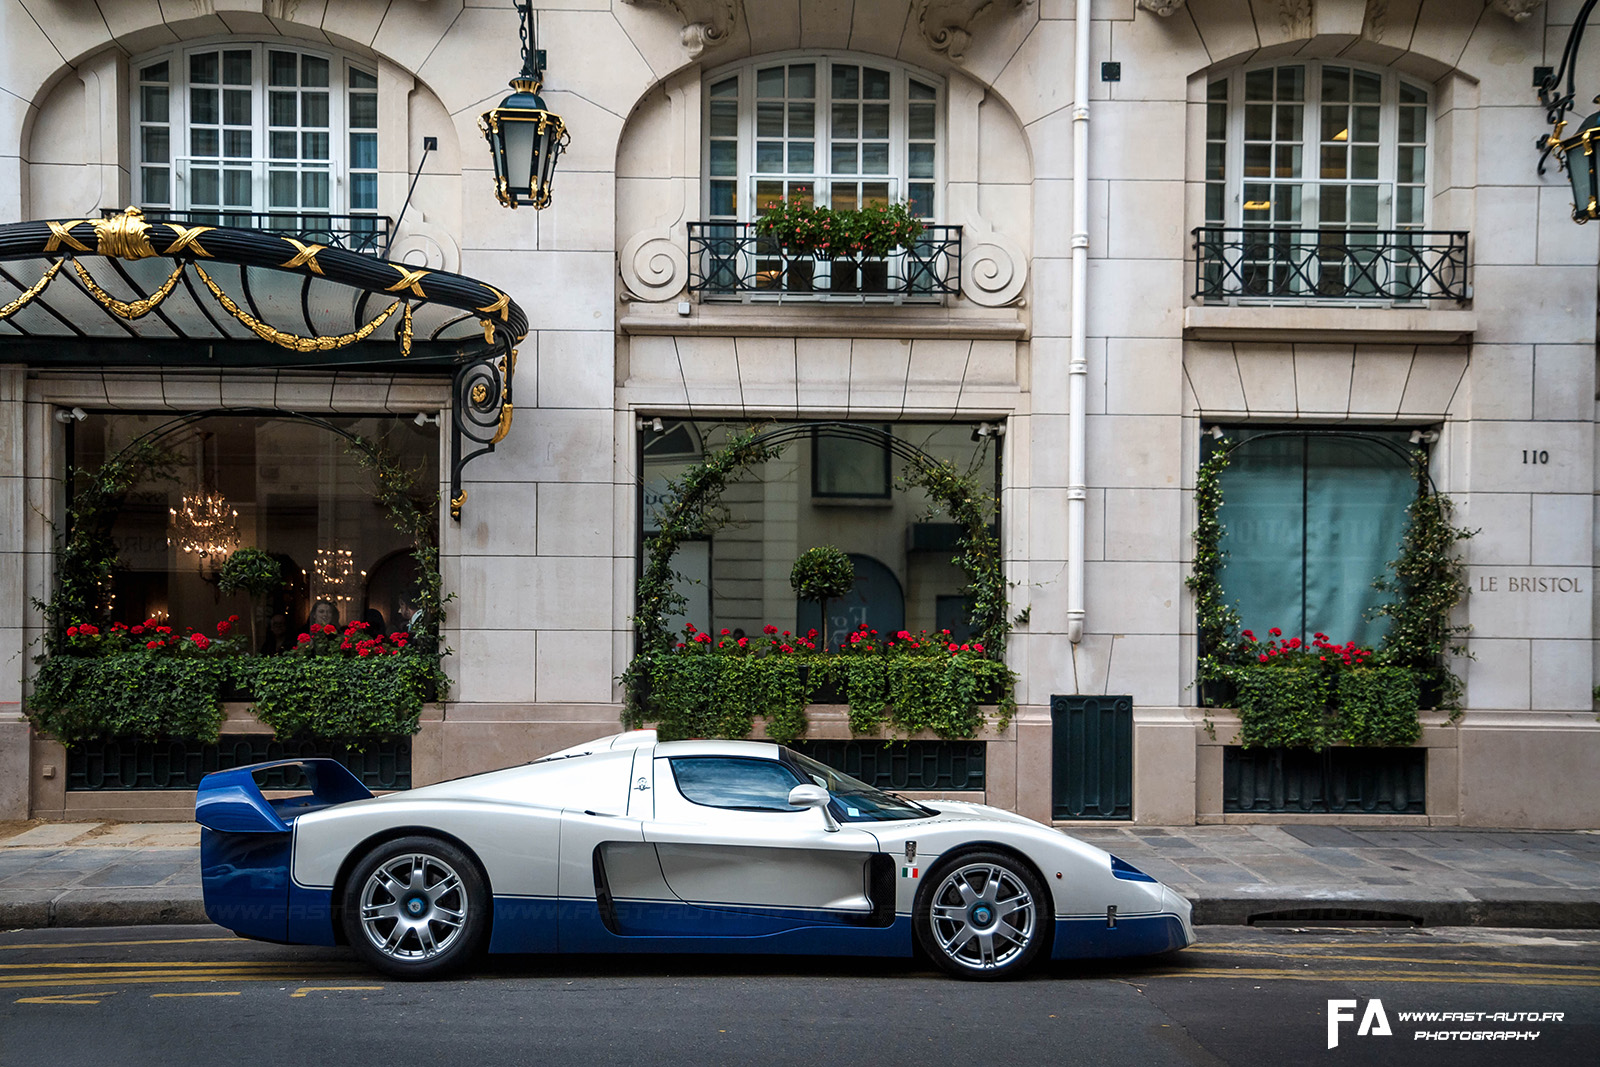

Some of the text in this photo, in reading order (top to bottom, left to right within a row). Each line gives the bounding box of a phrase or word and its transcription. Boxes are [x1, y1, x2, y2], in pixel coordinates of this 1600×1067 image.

[1522, 450, 1549, 464] 110
[1480, 576, 1583, 593] LE BRISTOL
